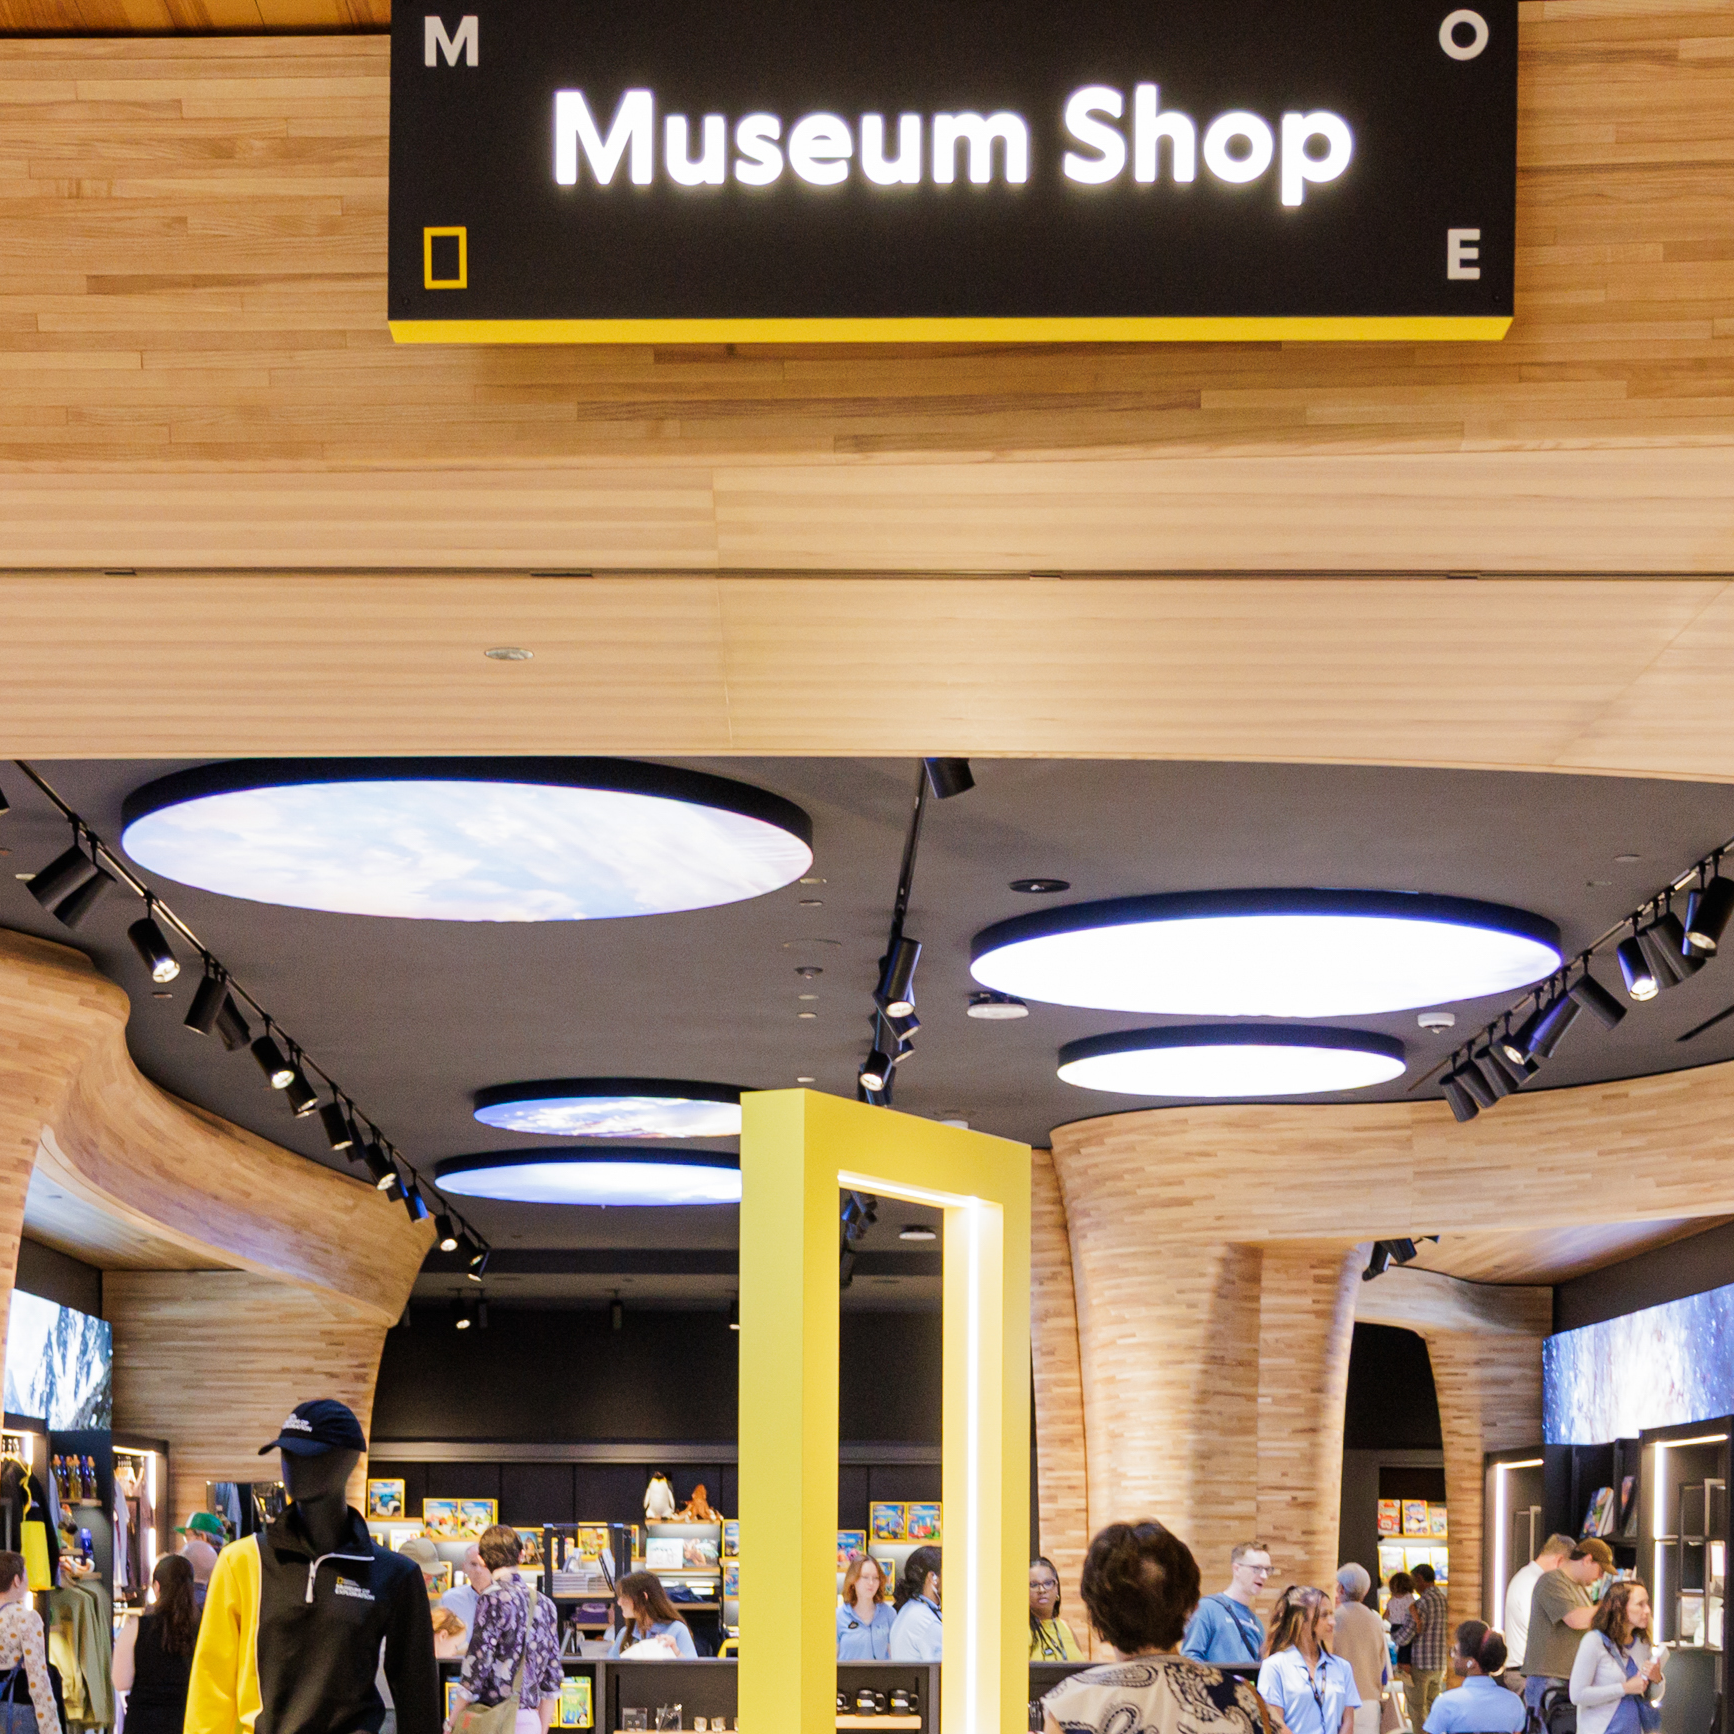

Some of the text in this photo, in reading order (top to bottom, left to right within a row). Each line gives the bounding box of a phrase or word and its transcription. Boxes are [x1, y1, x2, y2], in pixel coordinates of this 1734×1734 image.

[425, 15, 479, 67] M
[1439, 9, 1489, 61] O
[554, 83, 1354, 207] Museum Shop
[1447, 229, 1481, 280] E
